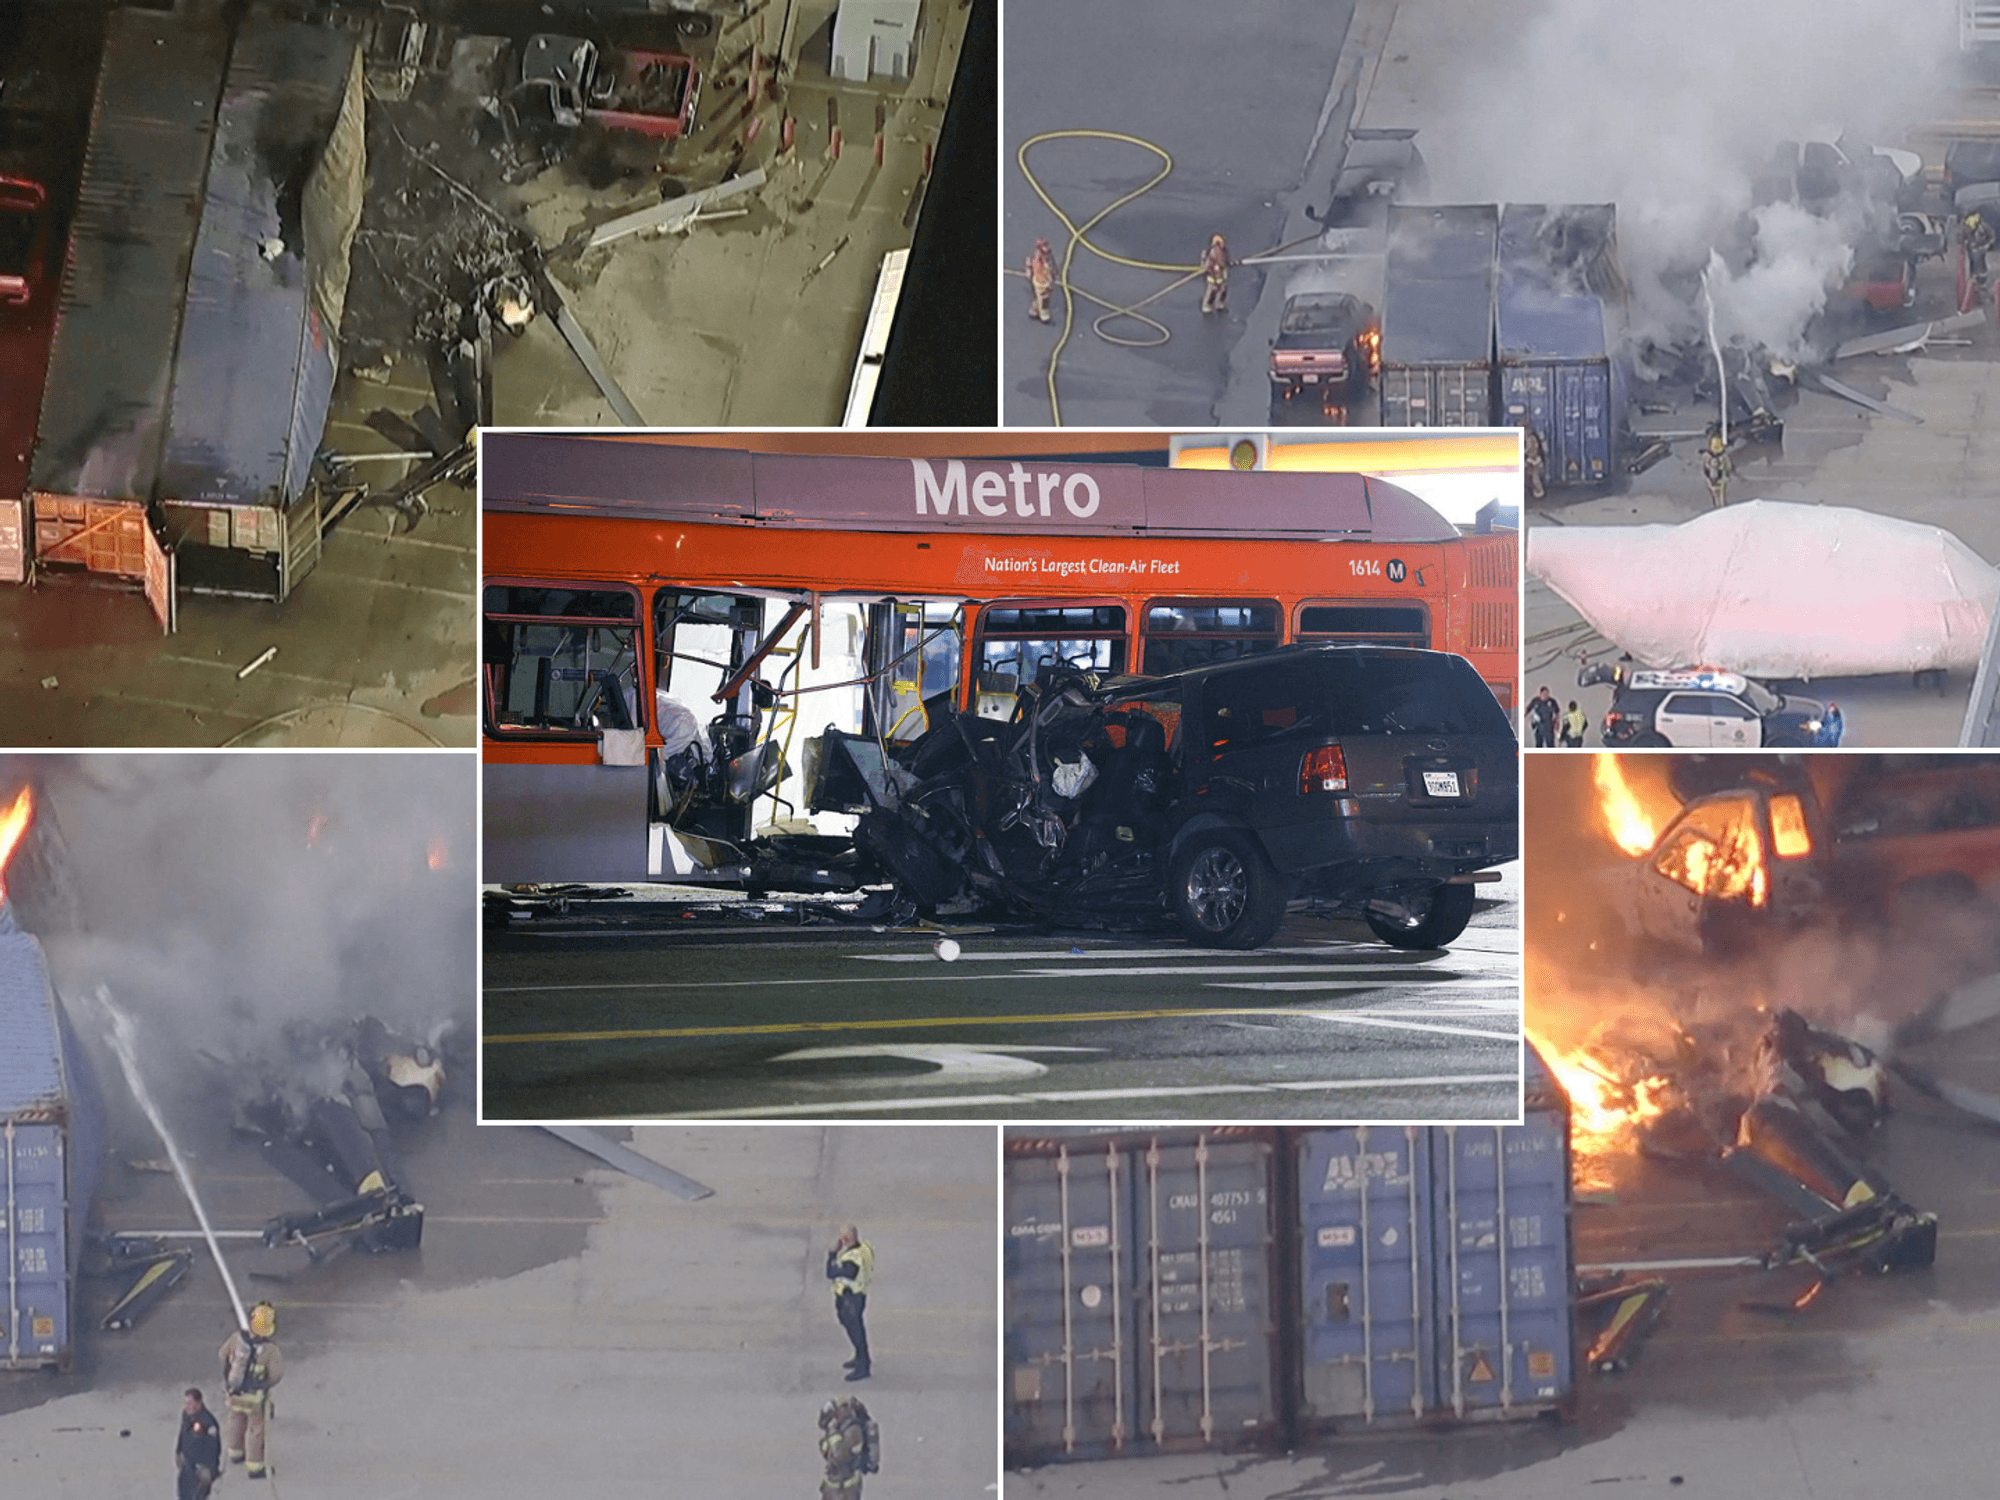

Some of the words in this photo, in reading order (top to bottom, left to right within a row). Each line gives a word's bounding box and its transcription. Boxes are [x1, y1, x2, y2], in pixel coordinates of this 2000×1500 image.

[911, 458, 1100, 518] Metro
[985, 557, 1037, 573] Nation's
[1042, 558, 1085, 577] Largest
[1089, 558, 1146, 574] Clean-Air
[1150, 560, 1180, 574] Fleet
[1349, 560, 1380, 576] 1614
[1389, 562, 1403, 579] M
